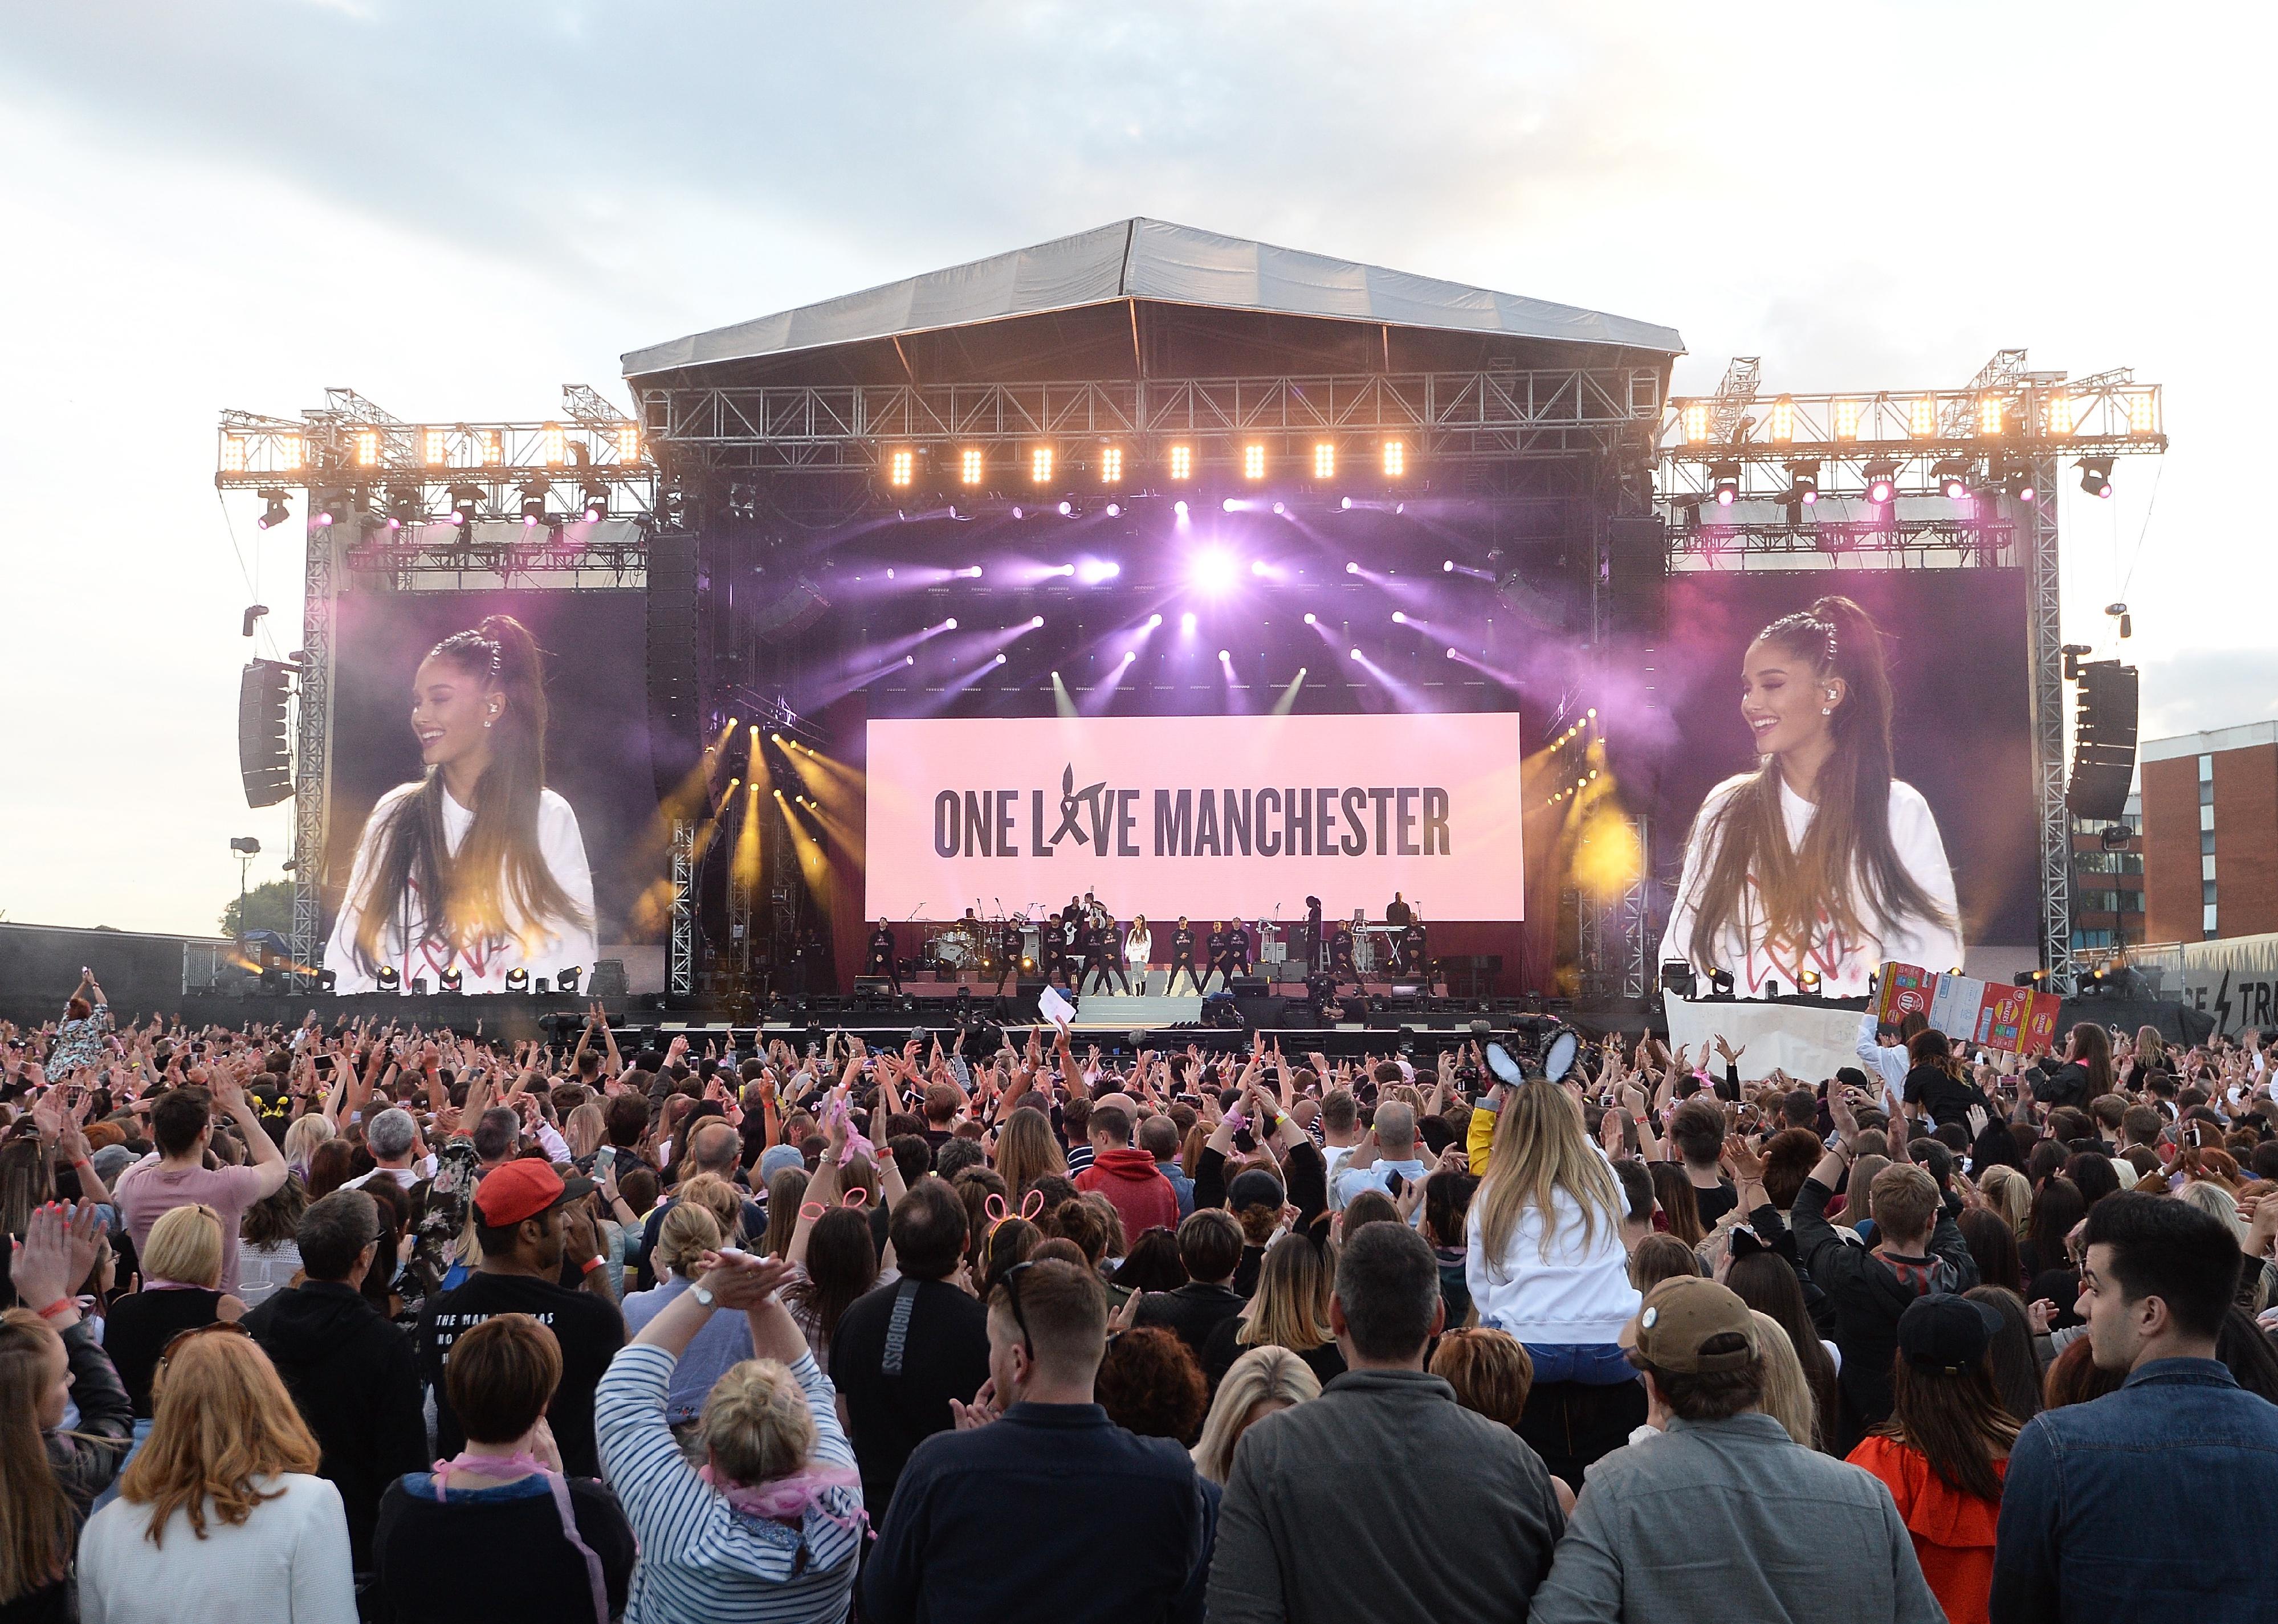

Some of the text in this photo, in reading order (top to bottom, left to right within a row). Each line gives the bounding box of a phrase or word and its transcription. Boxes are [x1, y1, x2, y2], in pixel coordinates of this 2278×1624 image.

[935, 789, 1018, 858] ONE
[1154, 786, 1450, 858] MANCHESTER
[1900, 995, 1914, 1010] 40
[2002, 1001, 2013, 1023] WALKERS
[435, 1315, 457, 1326] THE
[530, 1312, 554, 1324] AS
[437, 1333, 453, 1345] NO
